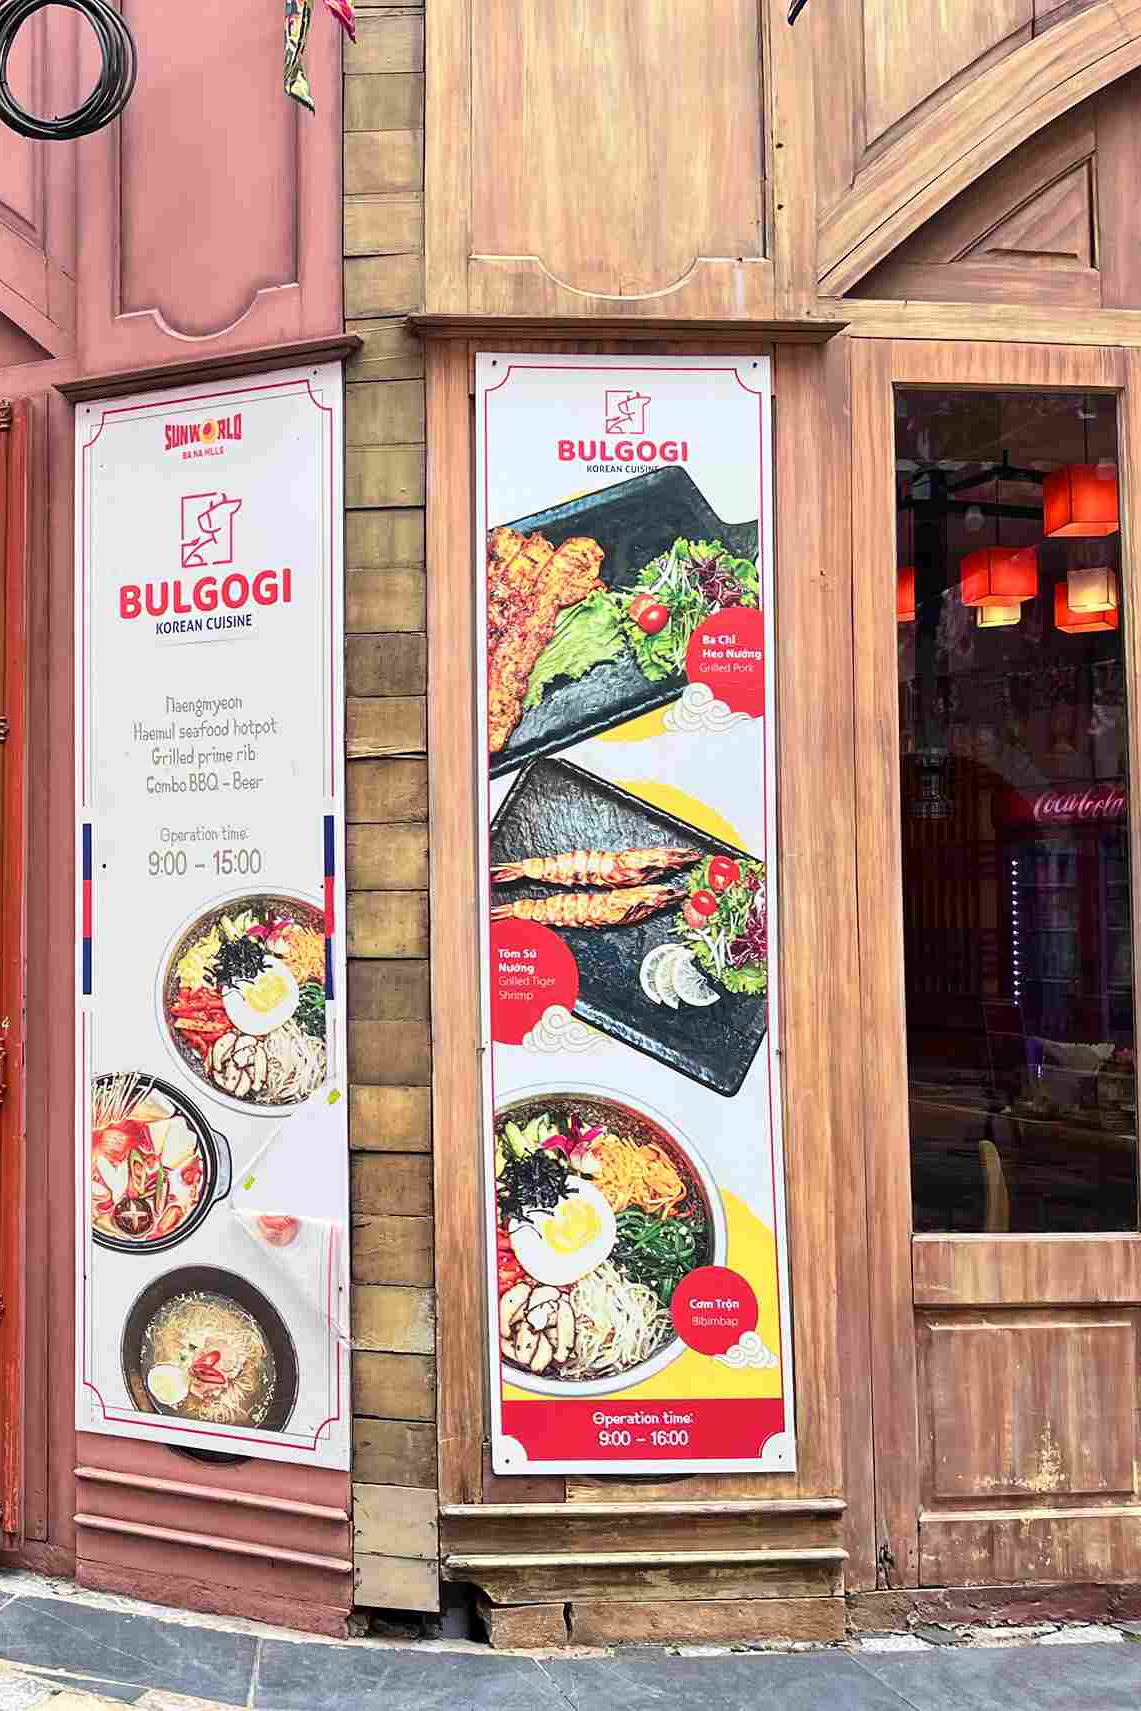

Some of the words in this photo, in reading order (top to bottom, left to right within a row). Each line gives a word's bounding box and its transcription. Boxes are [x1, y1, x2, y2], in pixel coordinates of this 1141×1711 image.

[557, 439, 688, 462] BULGOGI
[586, 464, 623, 473] KOREAN
[120, 568, 292, 619] BULGOGI
[155, 619, 203, 635] KOREAN
[206, 613, 252, 631] CUISINE
[703, 649, 724, 659] Heo
[699, 662, 731, 673] Grilled
[733, 662, 756, 673] Pork
[133, 721, 175, 742] Haemul
[179, 718, 229, 739] seafood
[233, 717, 278, 741] hotpot
[151, 746, 195, 766] Grilled
[198, 745, 234, 769] prime
[237, 743, 257, 761] rib
[146, 775, 187, 794] Combo
[188, 771, 220, 792] BBQ
[232, 770, 264, 791] Beer
[159, 824, 219, 847] Operation
[148, 850, 187, 876] 9:00
[212, 847, 262, 876] 15:00
[498, 976, 530, 986] Grilled
[532, 976, 556, 989] Tiger
[498, 990, 534, 1003] Shrimp
[691, 1314, 739, 1329] Bibimbap
[592, 1411, 660, 1428] Operation
[598, 1430, 632, 1447] 9:00
[650, 1430, 689, 1446] 16:00
